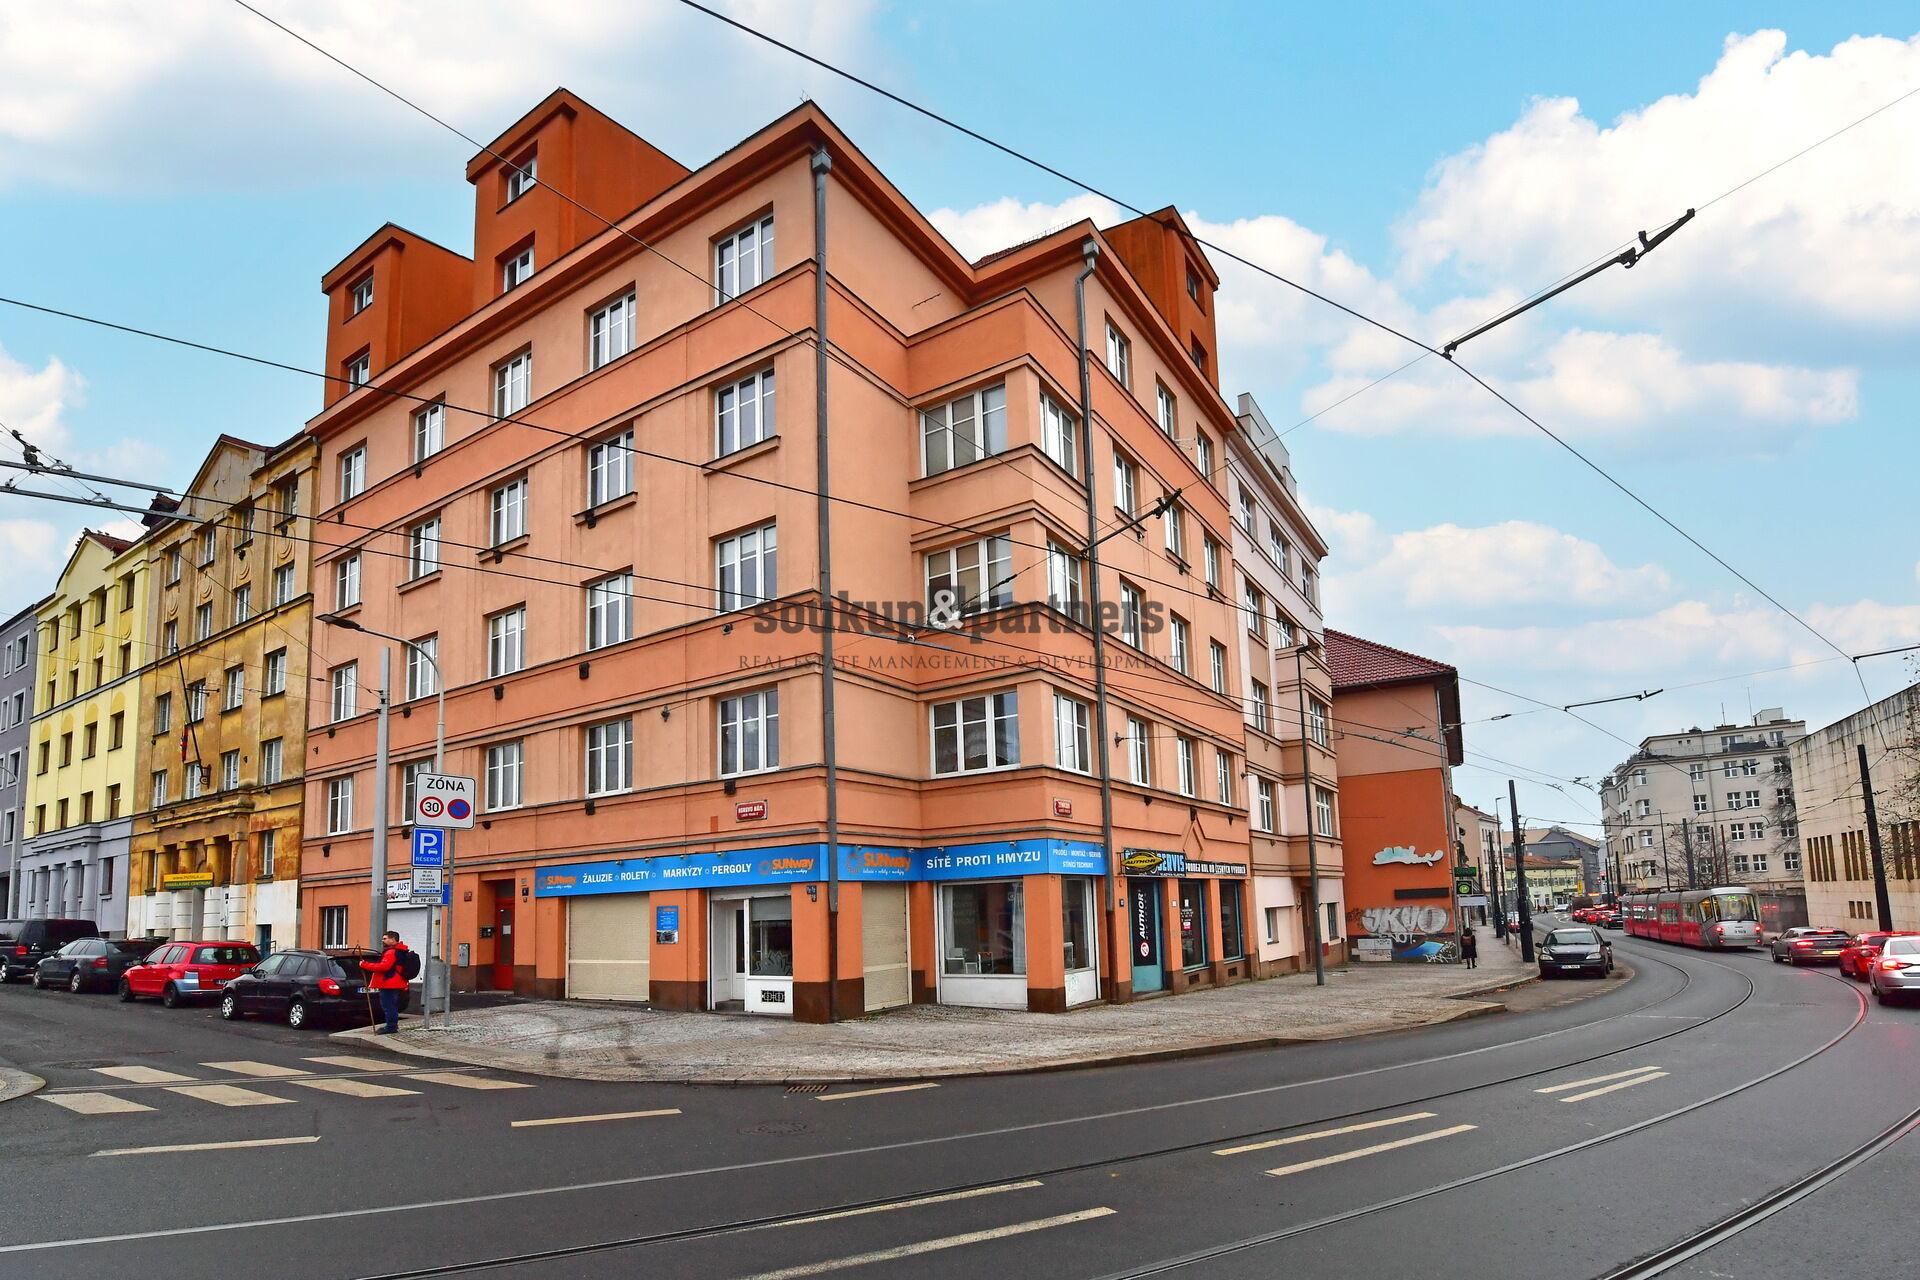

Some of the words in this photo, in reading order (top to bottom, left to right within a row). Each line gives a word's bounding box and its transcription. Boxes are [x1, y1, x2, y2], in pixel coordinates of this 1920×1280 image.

[426, 777, 466, 793] ZÓNA
[424, 801, 440, 813] 30
[420, 833, 437, 854] P
[772, 858, 814, 870] SUNway
[864, 852, 912, 872] SUNway
[926, 854, 951, 869] SÍTĚ
[957, 855, 991, 867] PROTI
[997, 851, 1041, 864] HMYZU
[1157, 853, 1185, 873] SERVIS
[583, 872, 613, 884] ŽALUZIE
[620, 870, 650, 881] ROLETY
[663, 864, 703, 878] MARKÝZY
[712, 863, 752, 875] PERGOLY
[397, 882, 410, 891] JUST
